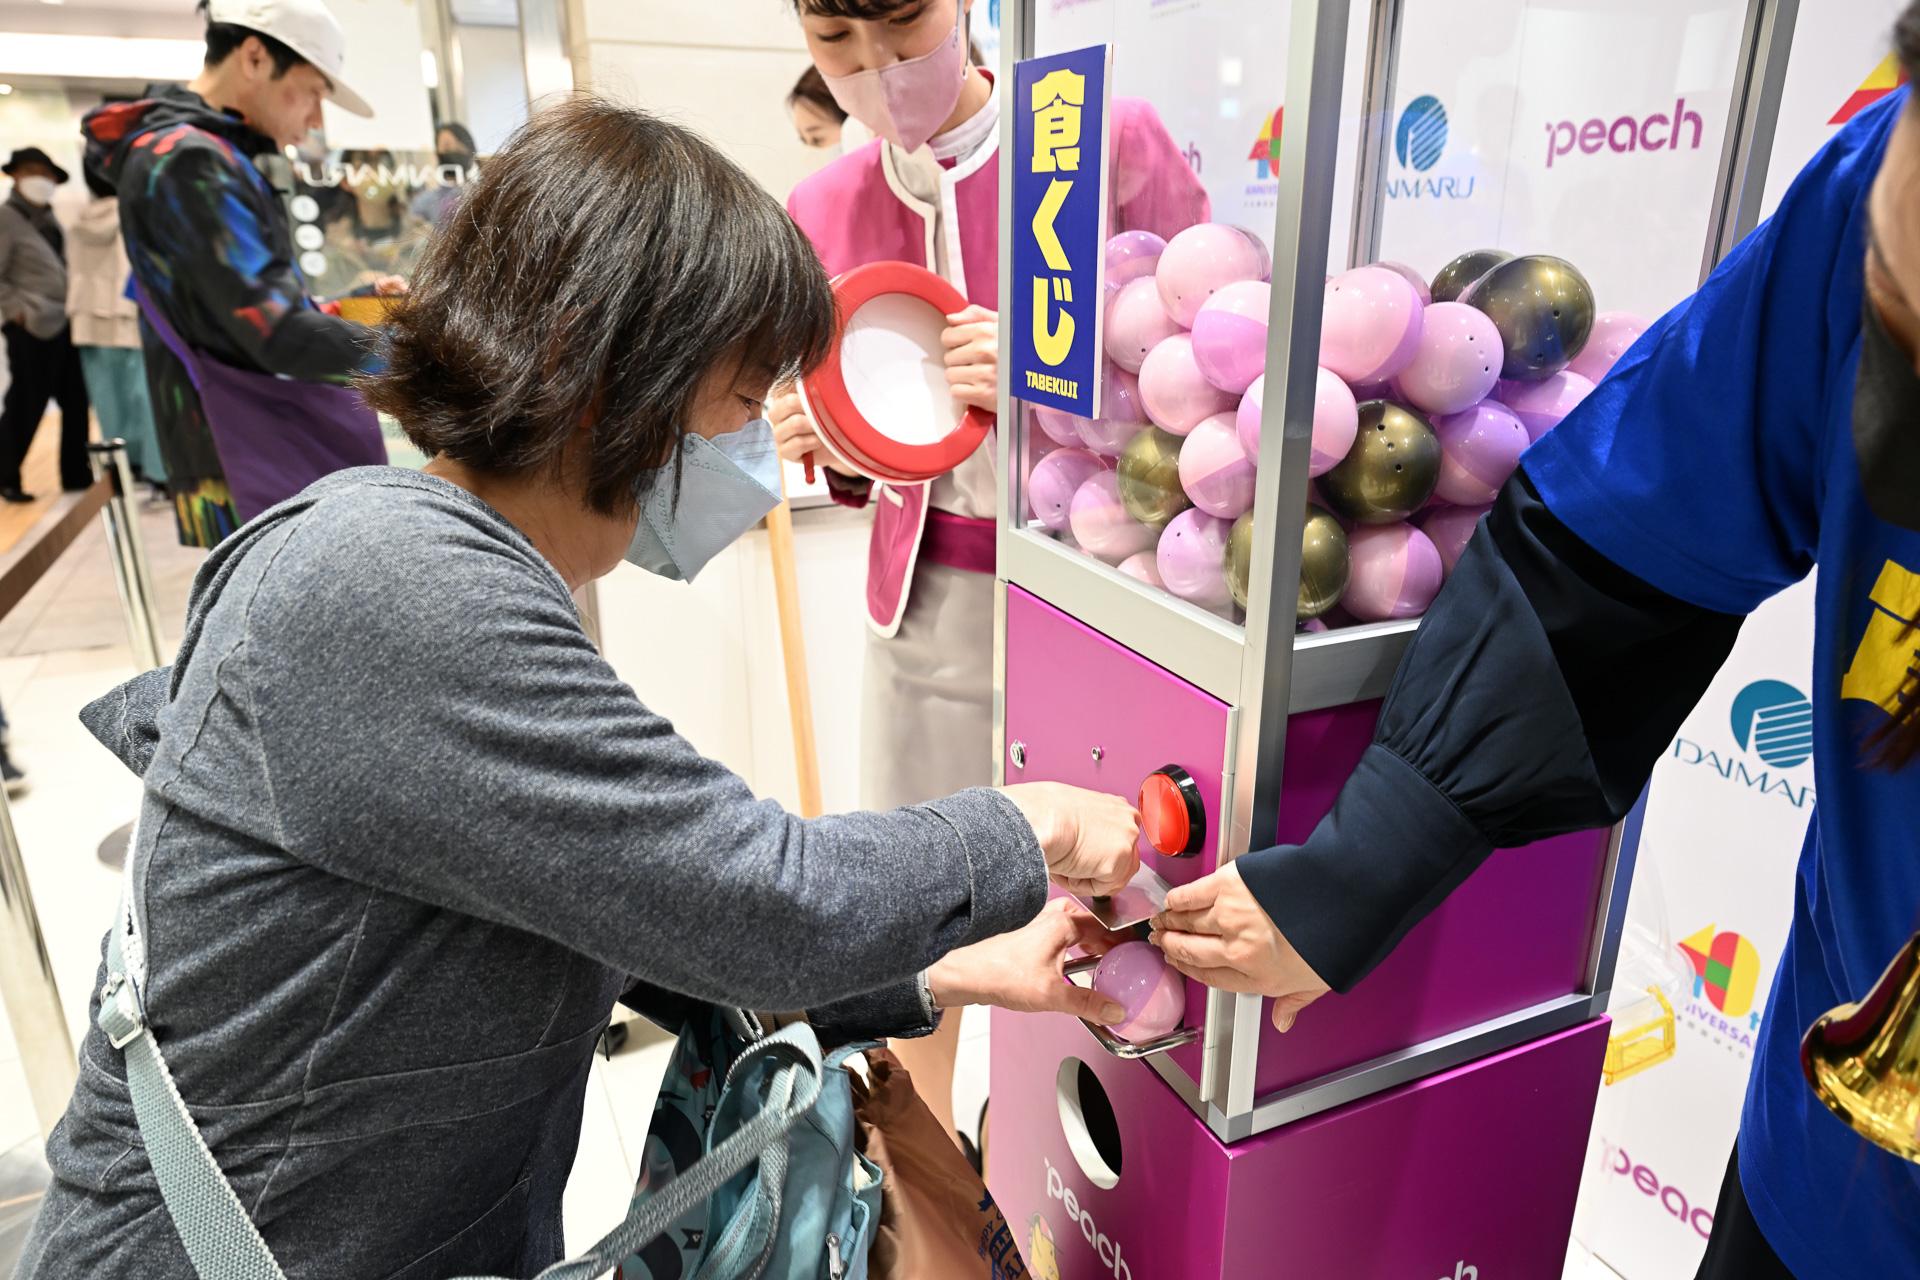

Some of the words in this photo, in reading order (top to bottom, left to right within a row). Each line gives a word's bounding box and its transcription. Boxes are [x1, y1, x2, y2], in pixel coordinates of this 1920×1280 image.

[1546, 98, 1703, 169] peach
[1031, 68, 1086, 367] 食くじ
[1026, 370, 1078, 400] TABEKUJI
[1674, 737, 1816, 809] DAIMAR
[1044, 1156, 1132, 1280] peach
[1601, 1136, 1714, 1240] peac
